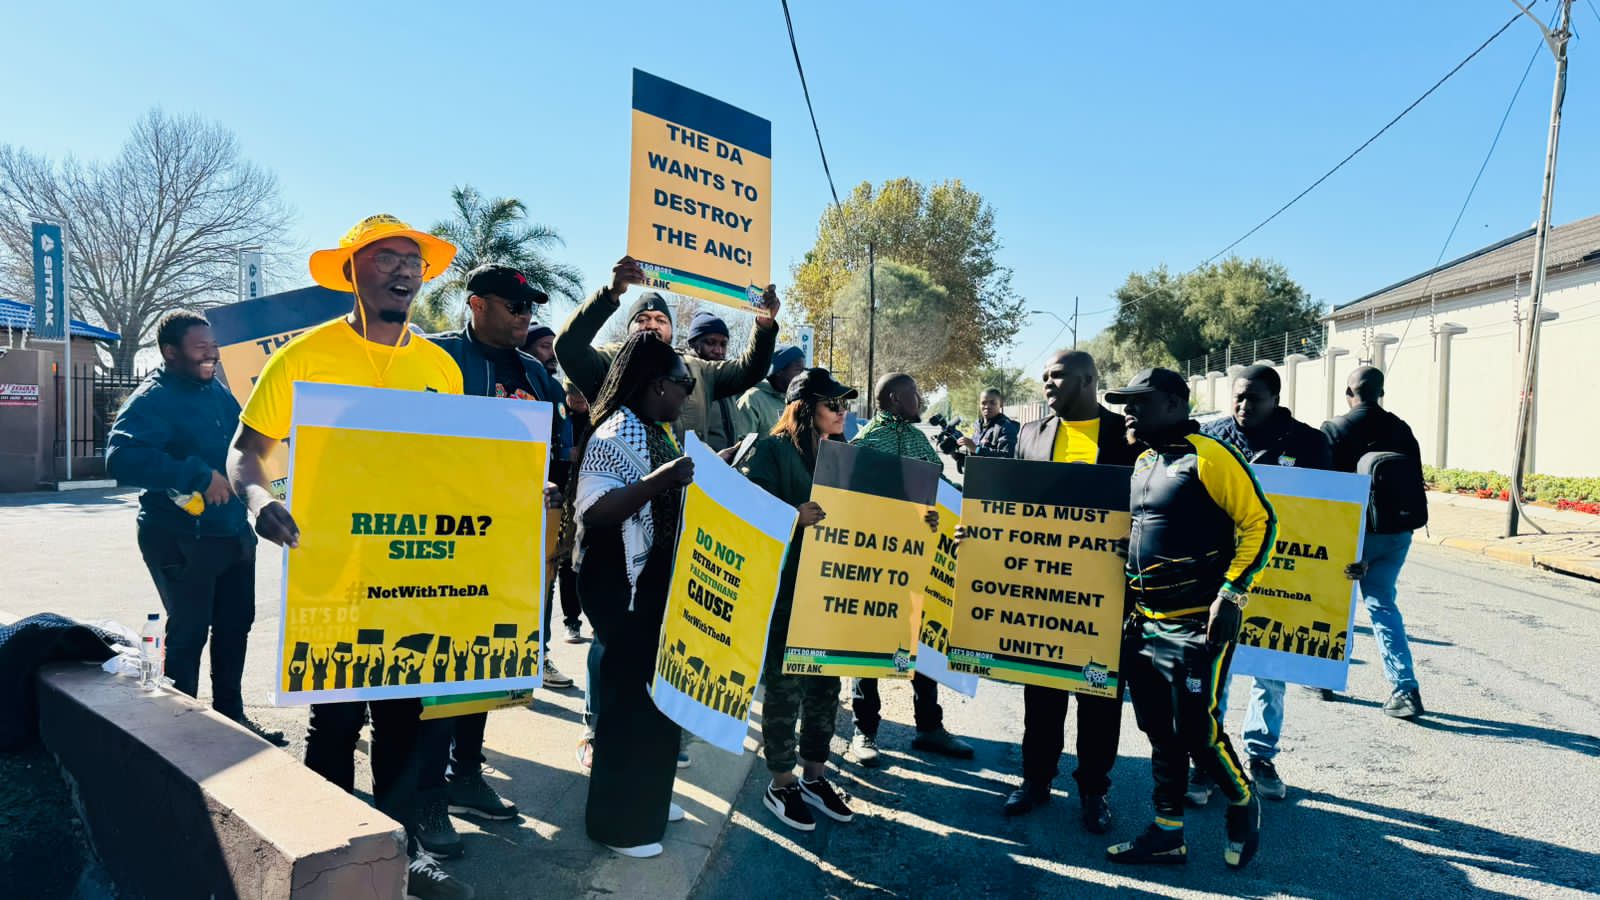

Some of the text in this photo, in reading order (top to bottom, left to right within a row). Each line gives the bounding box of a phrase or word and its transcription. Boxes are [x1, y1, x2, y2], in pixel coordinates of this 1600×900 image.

[666, 123, 743, 165] THE DA
[648, 152, 758, 202] WANTS TO
[654, 188, 752, 233] DESTROY
[652, 223, 752, 266] THE ANC!
[43, 255, 54, 327] SITRAK
[351, 513, 492, 536] RHA! DA?
[981, 500, 1110, 523] THE DA MUST
[388, 540, 456, 560] SIES!
[696, 528, 745, 571] DO NOT
[813, 525, 925, 556] THE DA IS AN
[966, 525, 1120, 553] NOT FORM PART
[692, 549, 741, 588] BETRAY THE
[934, 551, 946, 567] IN
[1004, 556, 1073, 576] OF THE
[820, 561, 909, 587] ENEMY TO
[930, 565, 955, 589] NAM
[687, 579, 734, 623] CAUSE
[971, 579, 1105, 608] GOVERNMENT
[1251, 585, 1312, 602] WithTheDA
[823, 596, 899, 619] THE NDR
[971, 606, 1099, 636] OF NATIONAL
[999, 637, 1064, 660] UNITY!
[786, 663, 823, 674] VOTE ANC
[950, 662, 991, 676] VOTE ANC
